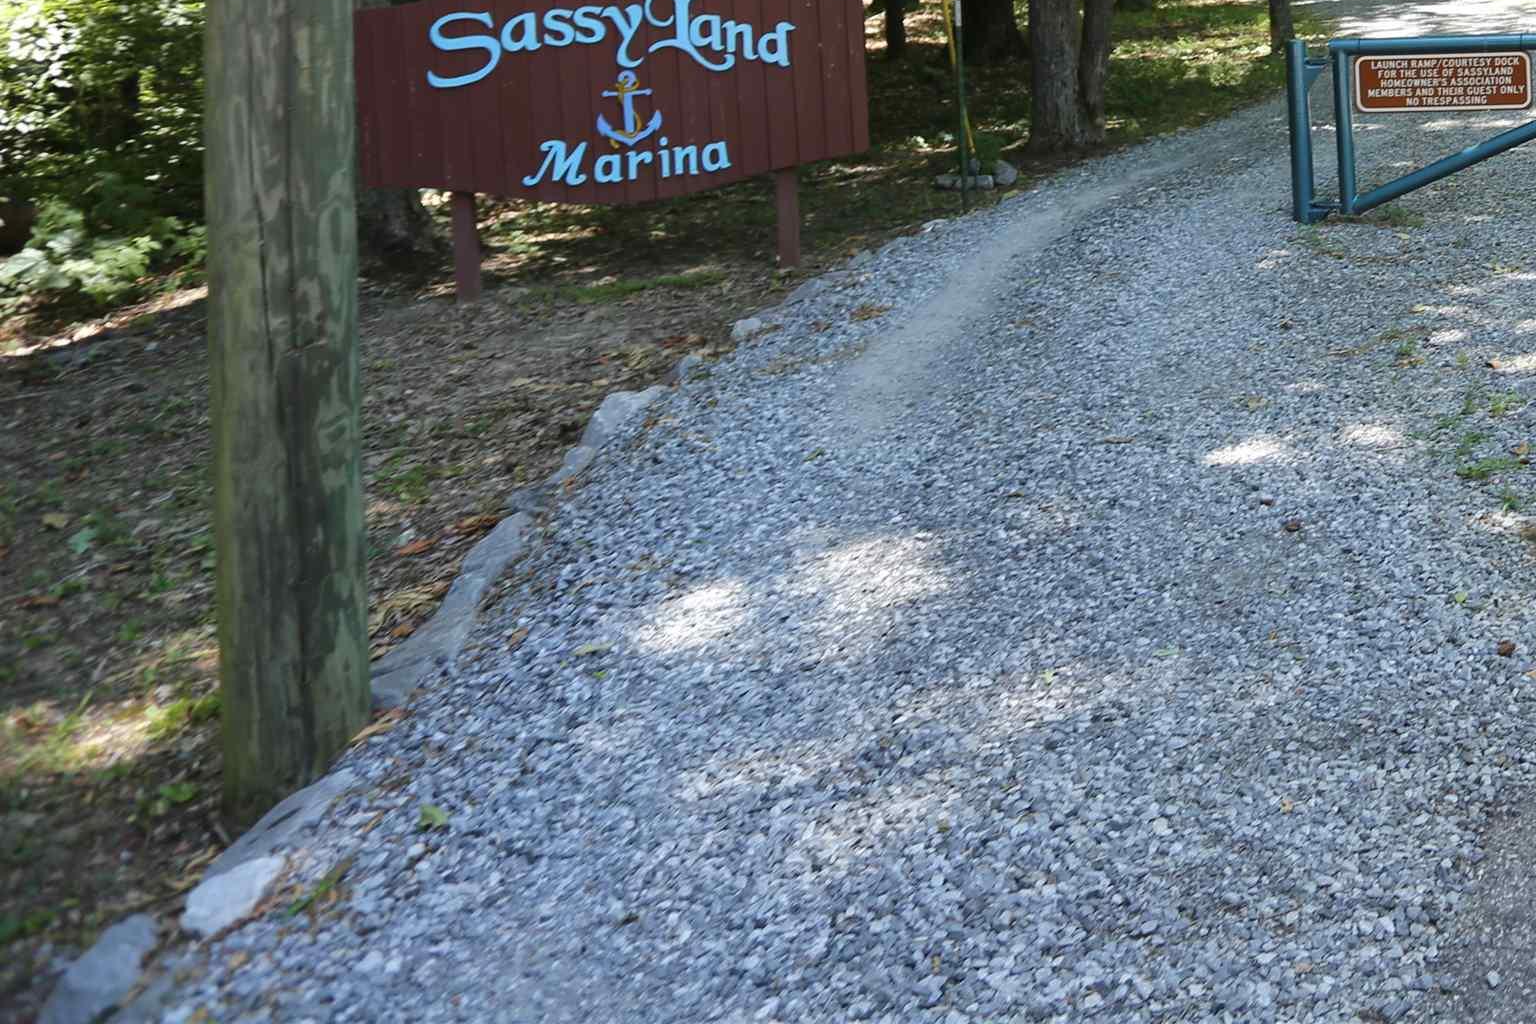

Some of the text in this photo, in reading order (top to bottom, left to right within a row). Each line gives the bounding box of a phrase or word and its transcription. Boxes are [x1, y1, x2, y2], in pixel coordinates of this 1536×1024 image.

[1371, 56, 1520, 70] LAUNCH RAMP/COURTESY DOCK
[1377, 66, 1513, 79] FOR THE USE OF SASSYLAND
[1381, 76, 1512, 88] HOMEOWNER'S ASSOCIATION
[1368, 84, 1525, 98] MEMBERS AND THEIR GUEST ONLY
[1407, 95, 1488, 107] NO TRESPASSING
[521, 136, 733, 187] Marina
